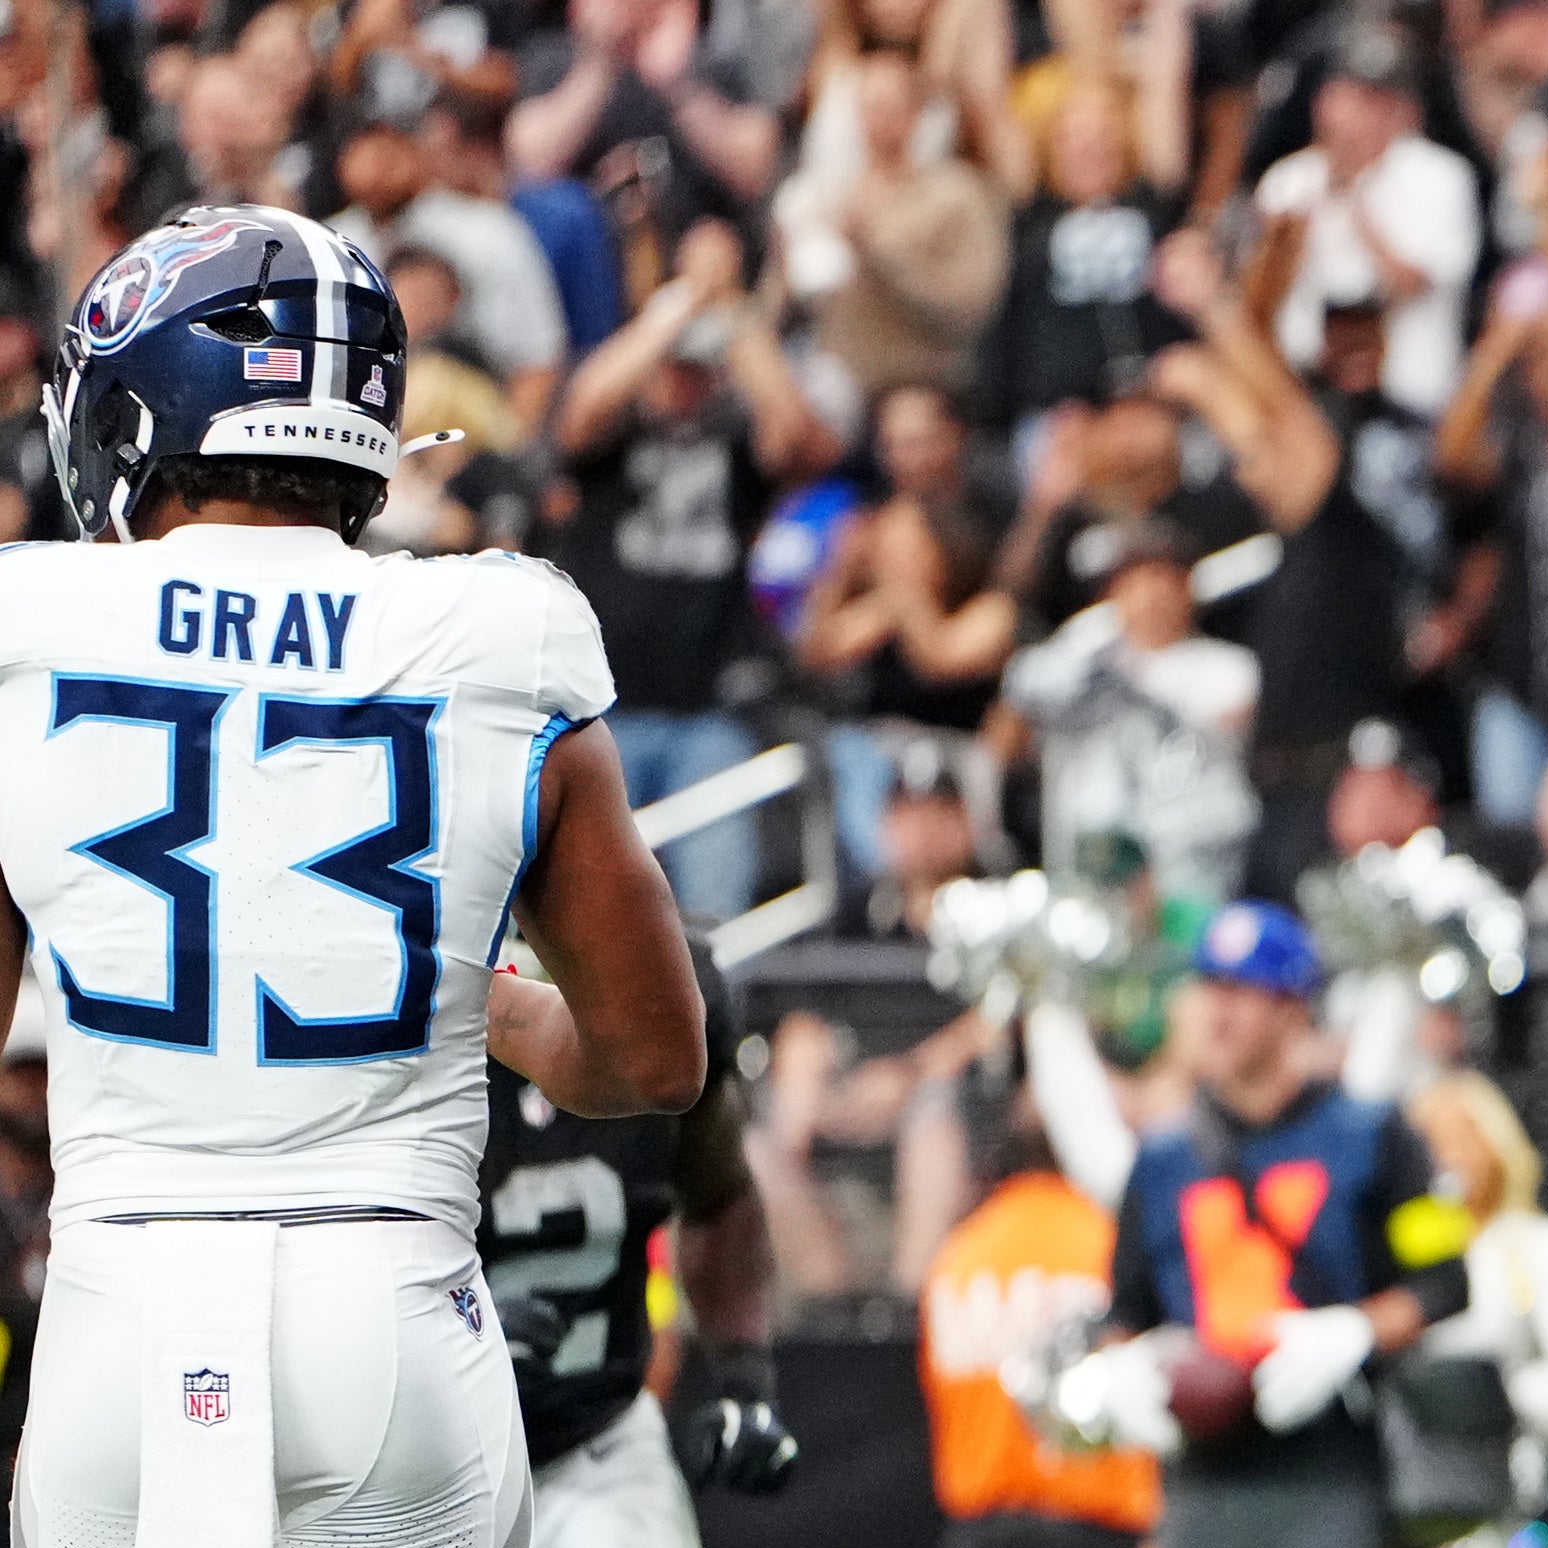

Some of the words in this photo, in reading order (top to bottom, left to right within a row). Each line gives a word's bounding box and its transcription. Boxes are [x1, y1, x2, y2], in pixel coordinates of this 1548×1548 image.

[243, 424, 388, 456] TENNESSEE
[156, 576, 361, 674] GRAY
[43, 671, 448, 1067] 33
[188, 1393, 226, 1421] NFL
